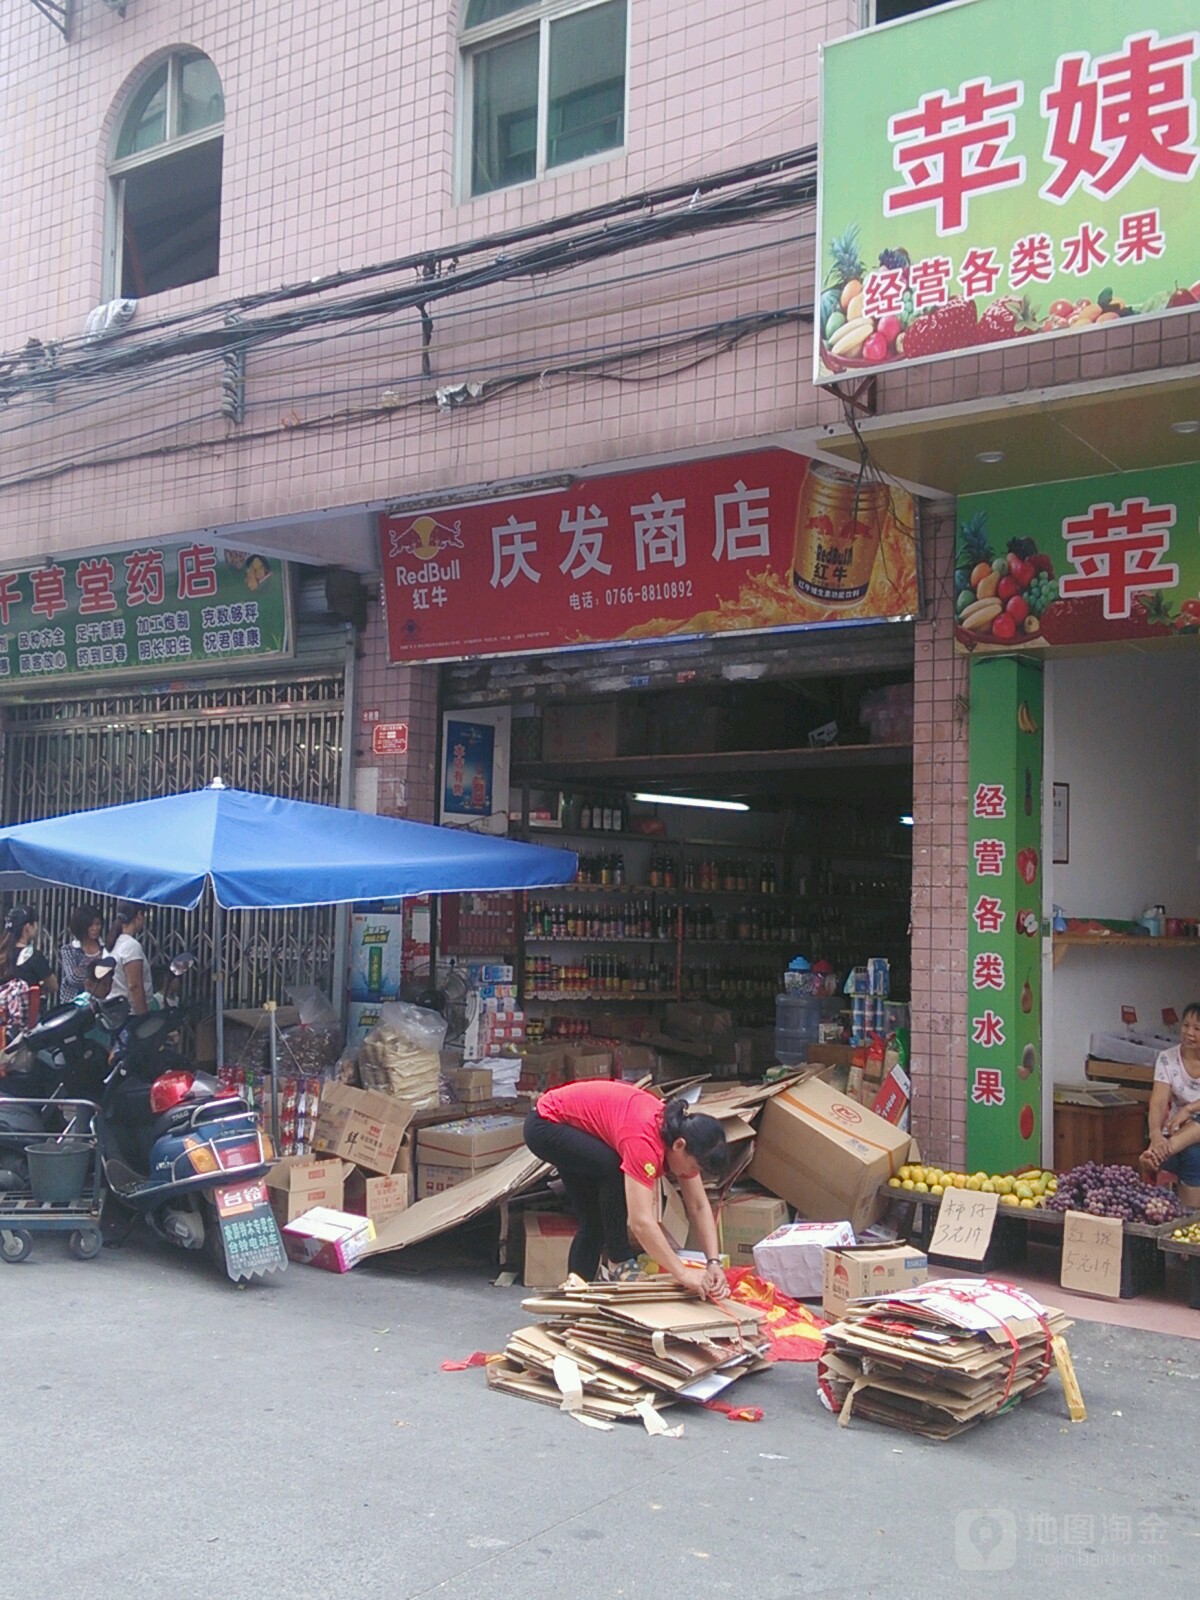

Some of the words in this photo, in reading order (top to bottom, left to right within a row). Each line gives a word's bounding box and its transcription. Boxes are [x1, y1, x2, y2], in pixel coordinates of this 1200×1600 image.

[884, 32, 1199, 234] 苹姨
[862, 209, 1167, 318] 经营各类水果
[489, 480, 772, 588] 庆发商店
[396, 560, 460, 586] RedBull
[797, 580, 861, 600] 红牛维生素功能饮料
[814, 562, 848, 583] 红牛
[412, 587, 448, 611] 红牛
[605, 580, 693, 606] 0766-8810892
[18, 627, 65, 651] 品种齐全
[76, 618, 125, 643] 足干新鲜
[136, 610, 190, 635] 加工炮制
[202, 601, 259, 628] 克数够秤
[19, 650, 67, 674] 顾客放心
[77, 643, 127, 667] 药到回春
[138, 635, 192, 660] 阴长阳生
[203, 627, 261, 653] 祝君健康
[973, 783, 1006, 1106] 经营各类水果
[223, 1187, 263, 1207] 台铃
